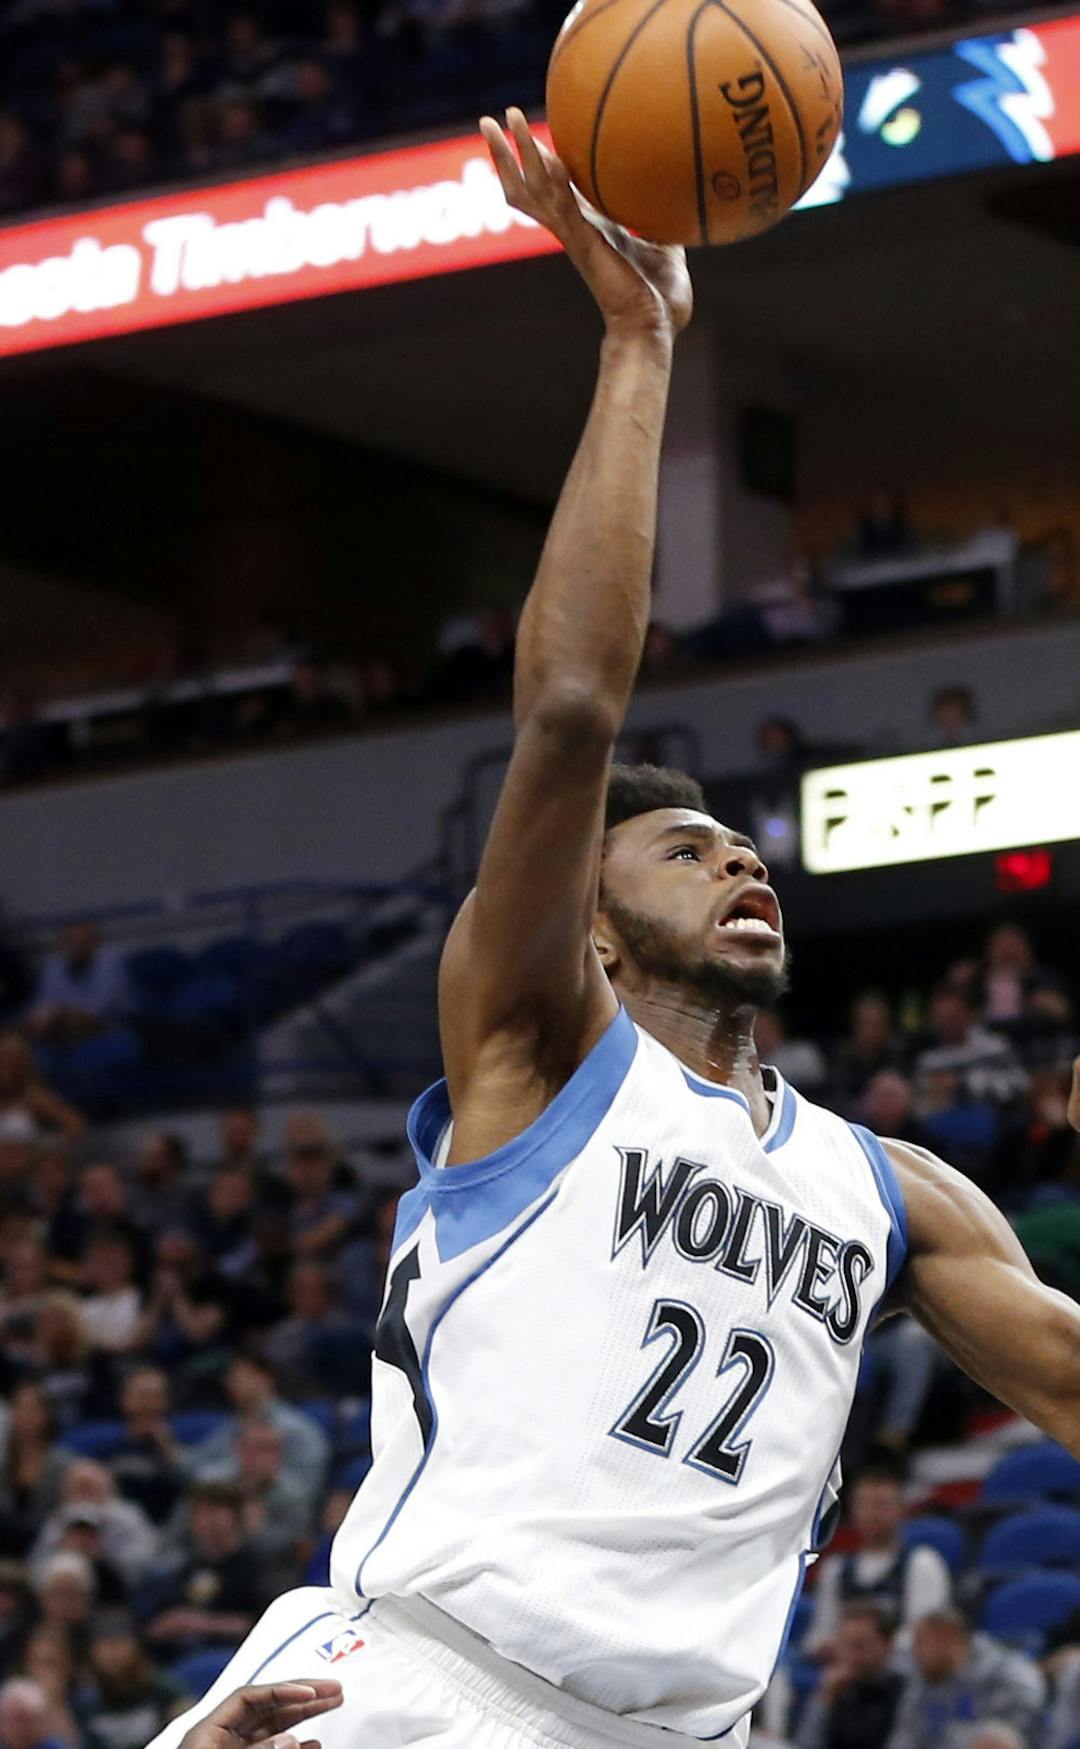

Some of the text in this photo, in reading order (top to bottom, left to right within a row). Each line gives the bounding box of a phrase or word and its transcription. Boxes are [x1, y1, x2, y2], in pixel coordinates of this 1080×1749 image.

[142, 157, 541, 297] Timberwol
[611, 1145, 875, 1345] WOLVES
[608, 1298, 776, 1487] 22
